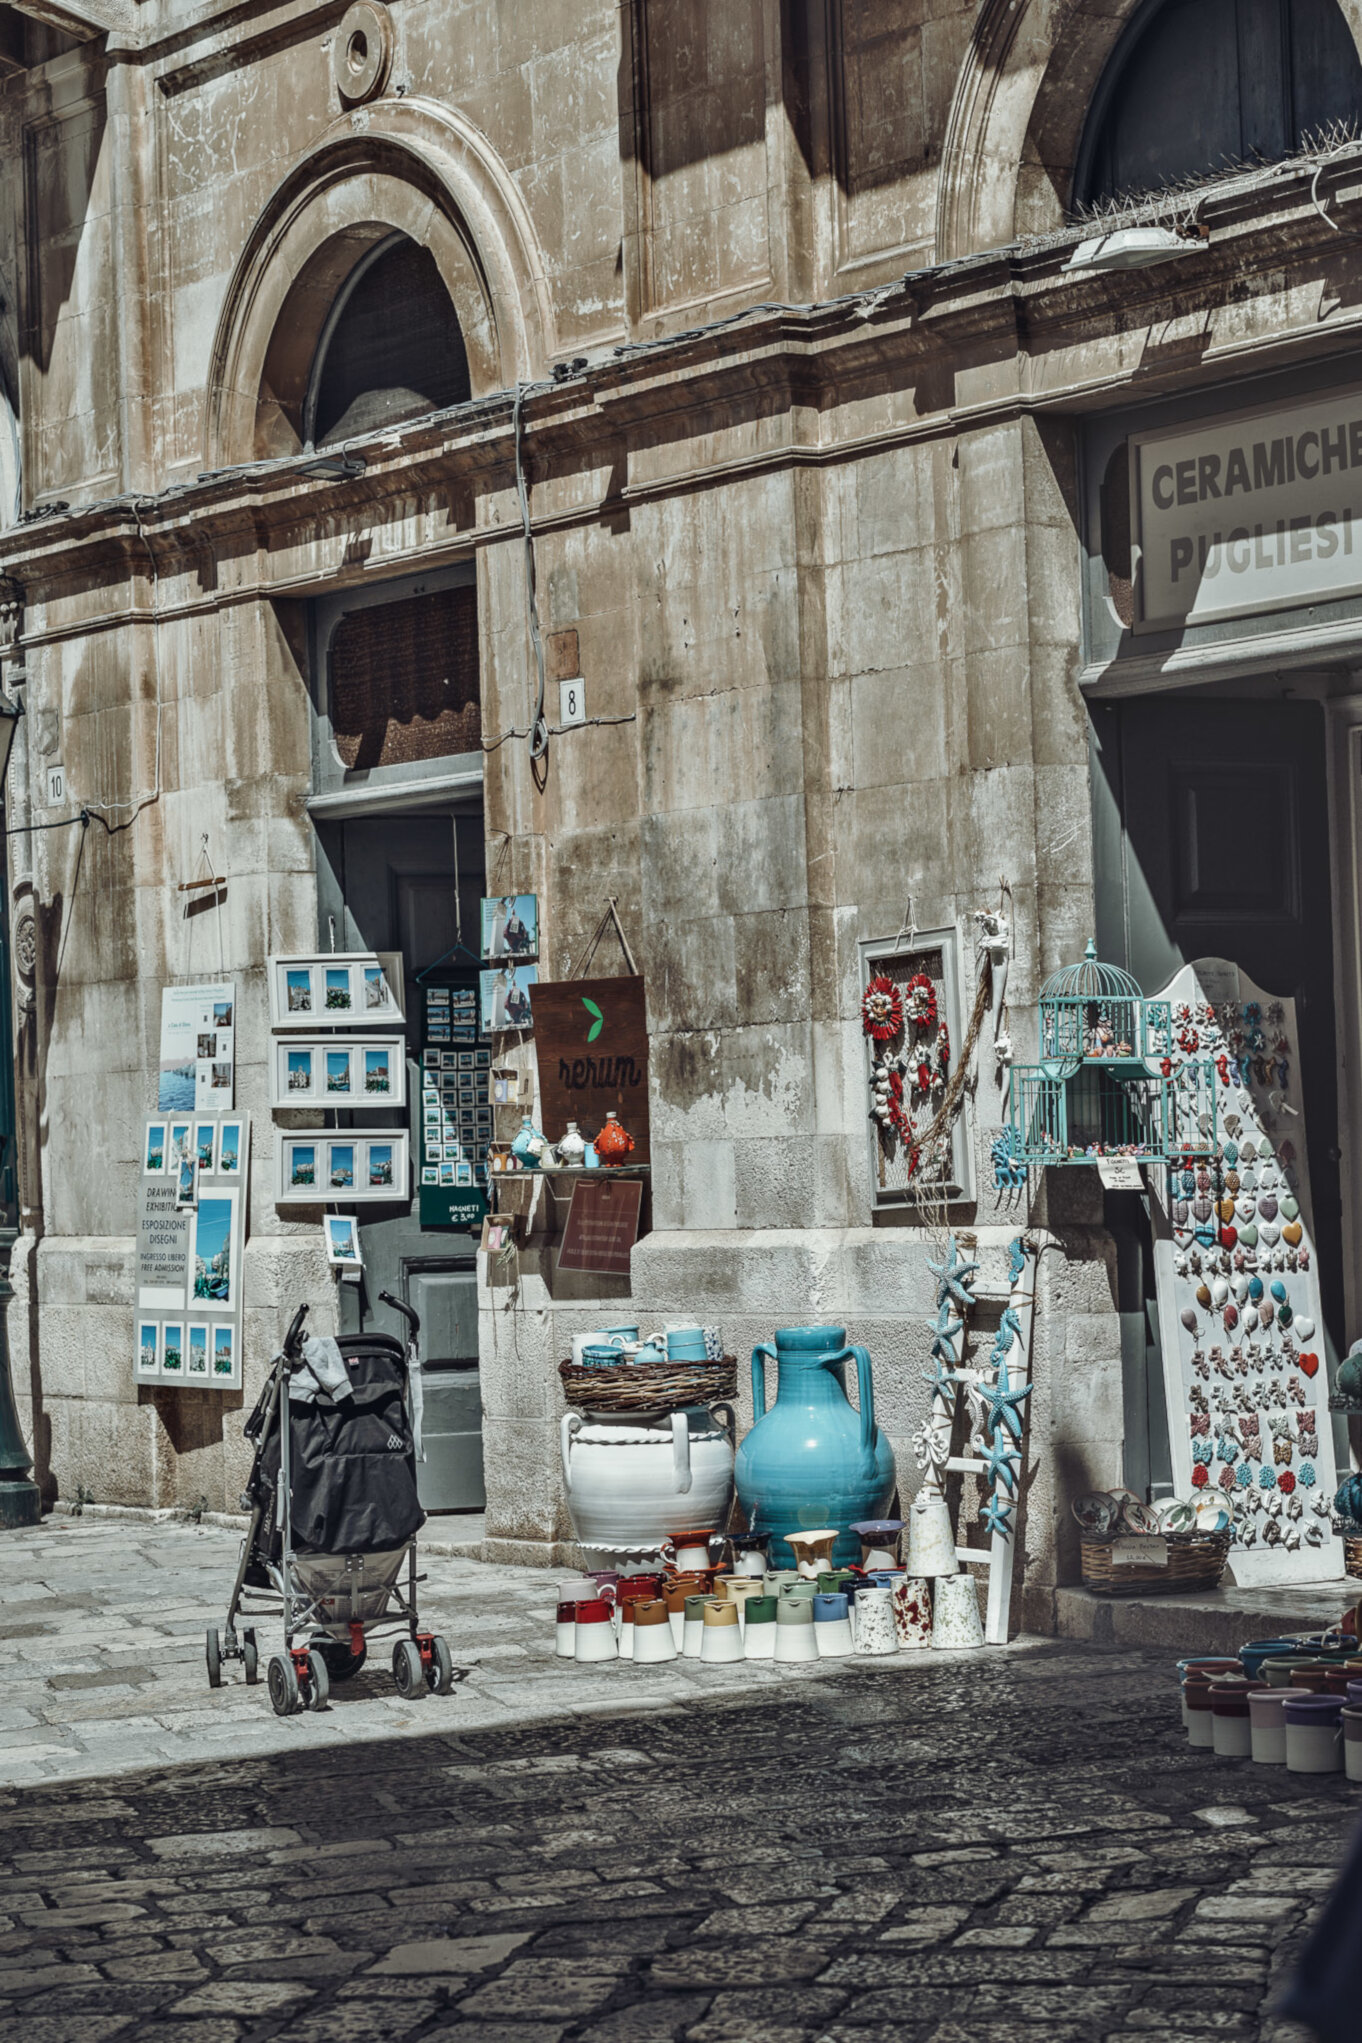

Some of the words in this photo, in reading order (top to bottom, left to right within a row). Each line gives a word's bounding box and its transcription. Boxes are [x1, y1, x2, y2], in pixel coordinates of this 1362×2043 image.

[1152, 420, 1362, 510] CERAMICHE
[1170, 508, 1353, 583] PUGLIESI
[568, 690, 577, 715] 8
[51, 775, 62, 798] 10
[147, 1187, 176, 1197] DRAWIN
[146, 1201, 178, 1211] EXHIBITI
[142, 1220, 186, 1230] ESPOSIZIONE
[149, 1234, 178, 1245] DISEGNI
[140, 1252, 167, 1261] INGRESSO
[167, 1253, 186, 1262] LIBERO
[141, 1263, 153, 1271] FREE
[154, 1263, 185, 1273] ADMISSION
